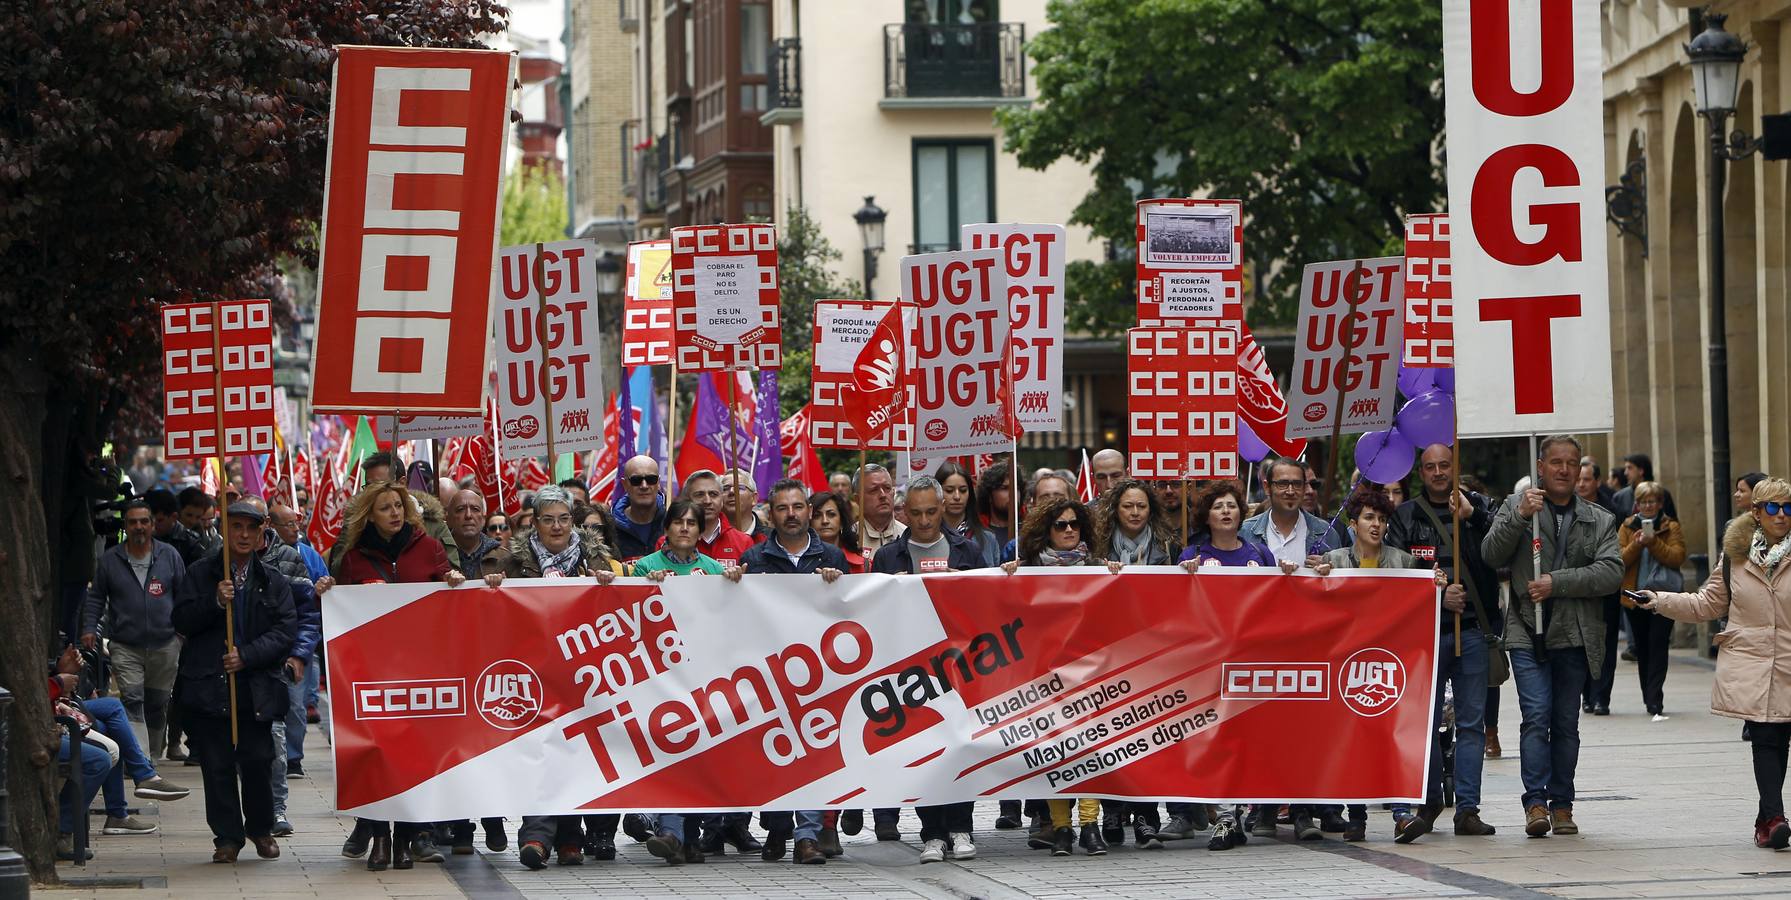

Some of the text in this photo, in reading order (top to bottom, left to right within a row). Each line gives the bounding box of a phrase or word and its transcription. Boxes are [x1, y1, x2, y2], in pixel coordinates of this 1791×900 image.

[350, 66, 472, 394] CCOO
[1470, 0, 1582, 415] UGT
[502, 248, 584, 300] UGT
[912, 258, 995, 308] UGT
[1311, 265, 1400, 308] UGT
[505, 301, 587, 353] UGT
[1008, 285, 1054, 329] GT
[1306, 309, 1394, 352] UGT
[691, 335, 716, 349] CCOO
[740, 328, 765, 344] CCOO
[920, 310, 998, 359] UGT
[508, 354, 590, 406] UGT
[919, 361, 1000, 410] UGT
[1302, 353, 1390, 395] UGT
[556, 594, 670, 662] mayo
[484, 674, 533, 704] UGT
[574, 629, 688, 706] 2018
[762, 618, 1025, 767] de ganar
[1228, 669, 1321, 692] CCOO
[1347, 660, 1399, 688] UGT
[360, 686, 458, 712] CCOO
[562, 620, 872, 783] Tiempo
[974, 672, 1065, 728] Igualdad
[999, 676, 1132, 750] Mejor empleo
[1023, 685, 1187, 770] Mayores salarios
[1047, 706, 1219, 791] Pensiones dignas
